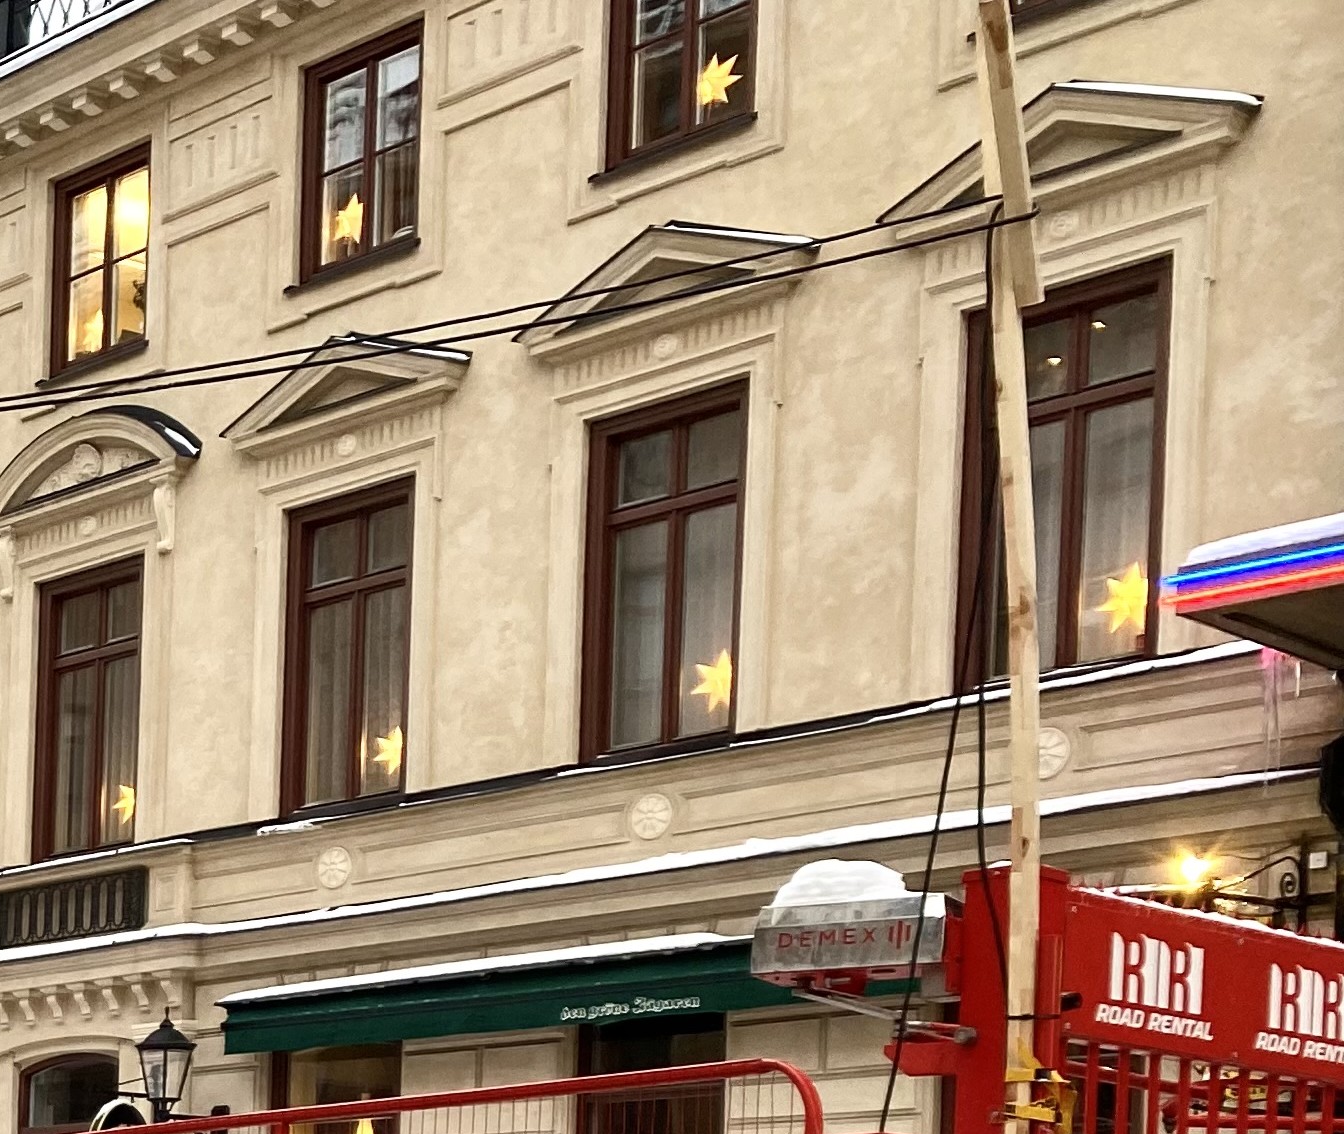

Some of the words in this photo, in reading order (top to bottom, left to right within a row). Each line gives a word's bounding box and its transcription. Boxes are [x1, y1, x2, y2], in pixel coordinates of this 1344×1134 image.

[777, 926, 877, 950] DEMEX
[1095, 1003, 1146, 1029] ROAD
[1147, 1012, 1214, 1041] RENTAL
[1255, 1031, 1301, 1057] ROAD
